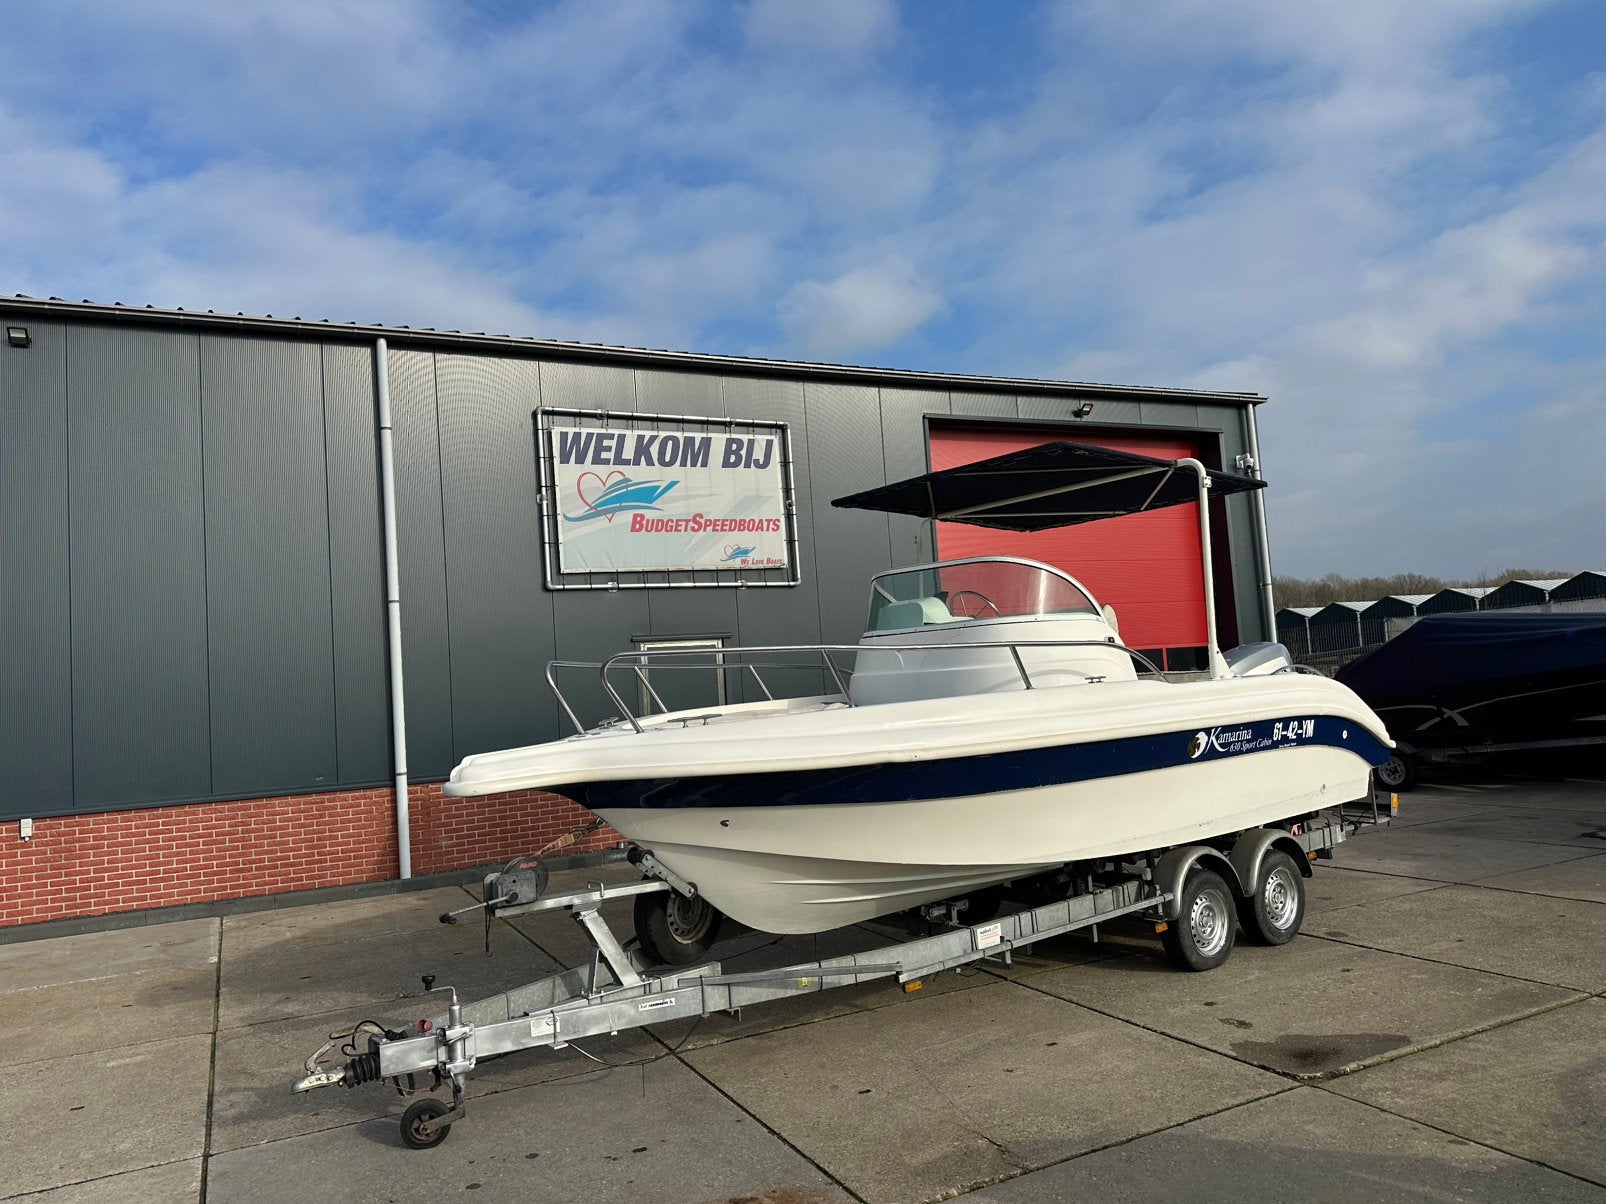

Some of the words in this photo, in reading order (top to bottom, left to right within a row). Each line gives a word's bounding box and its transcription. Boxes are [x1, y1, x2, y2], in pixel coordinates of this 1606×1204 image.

[559, 431, 712, 468] WELKOM
[721, 438, 774, 470] BIJ
[1204, 727, 1252, 754] Kamarina
[1273, 719, 1315, 741] 61-42-YM
[1240, 740, 1256, 752] Sport
[1256, 737, 1273, 748] Cabin
